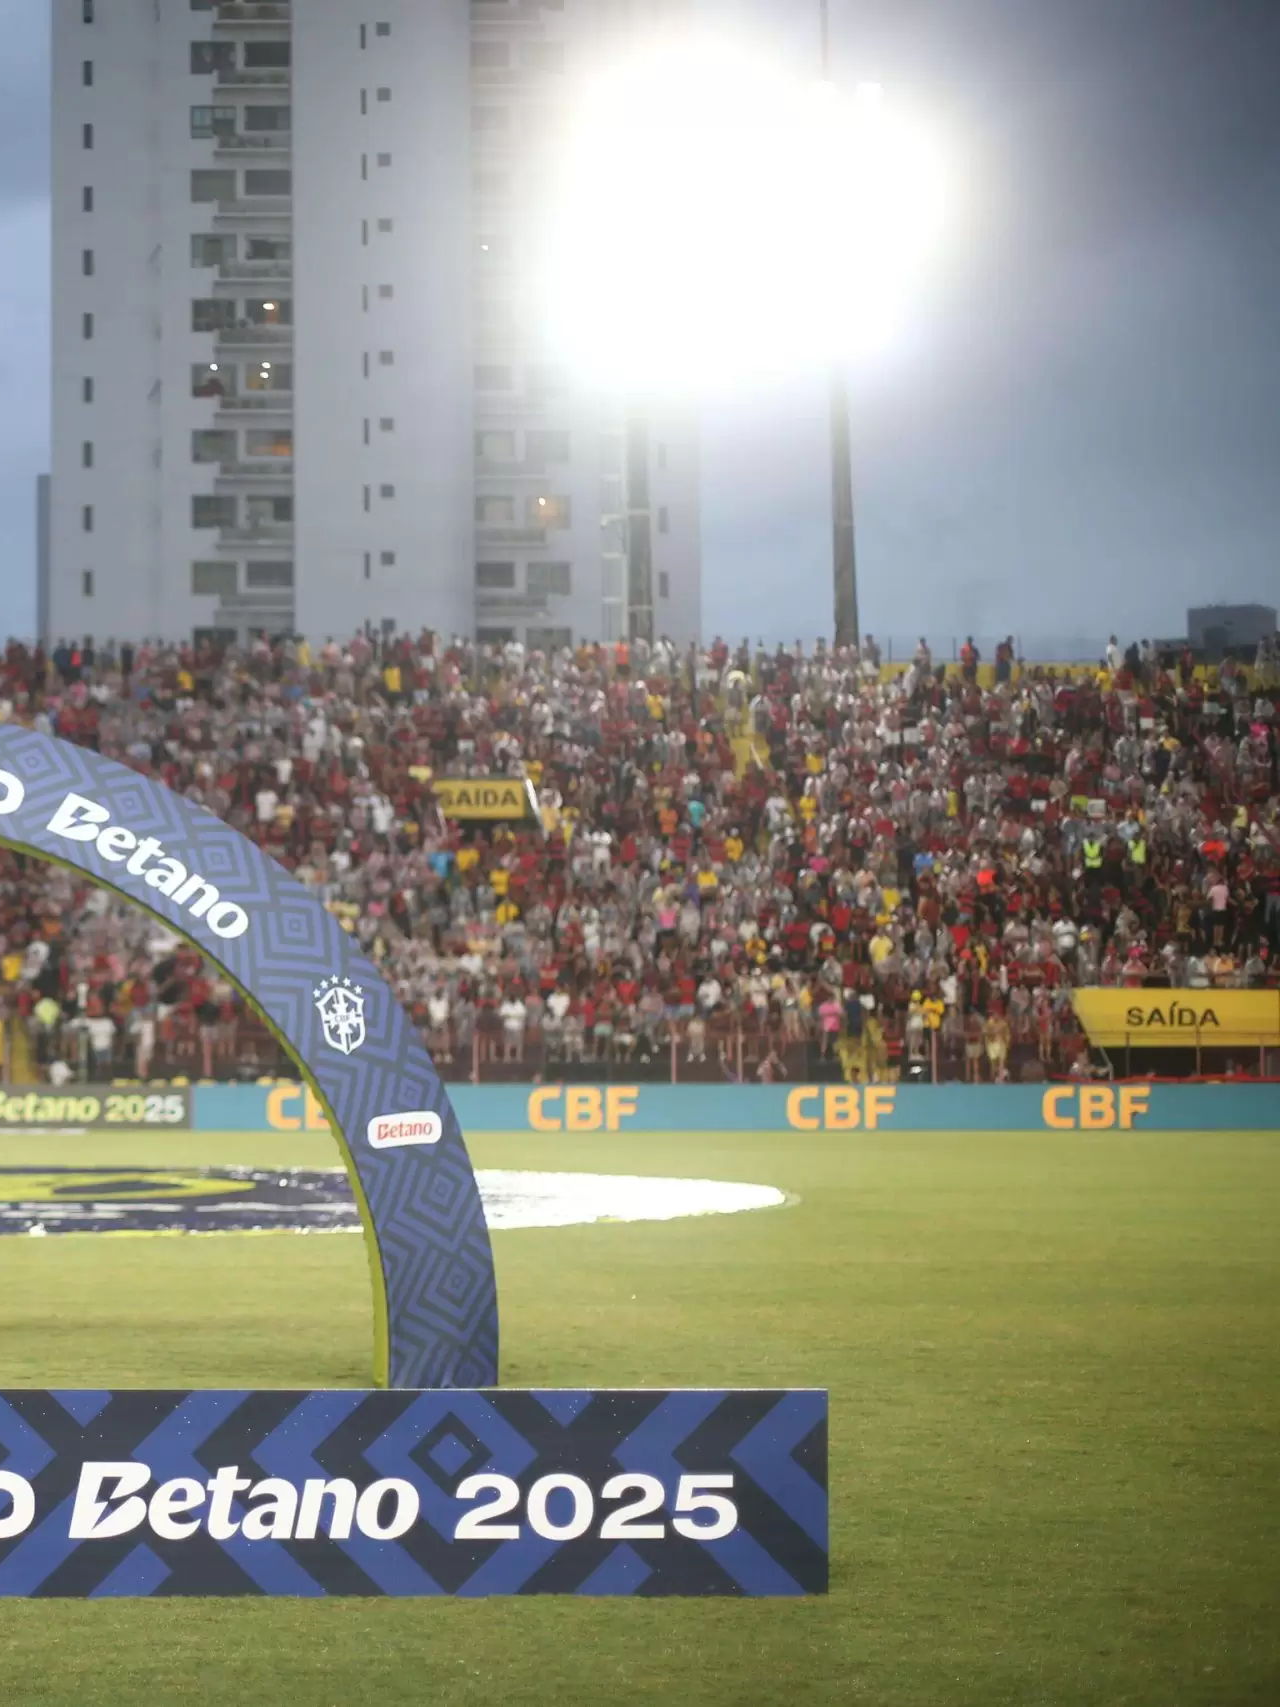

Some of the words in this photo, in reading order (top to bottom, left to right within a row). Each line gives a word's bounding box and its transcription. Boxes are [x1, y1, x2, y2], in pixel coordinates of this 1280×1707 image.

[46, 792, 250, 940] Betano
[1125, 1001, 1221, 1027] SAÍDA
[104, 1094, 185, 1122] 2025
[527, 1086, 639, 1131] CBF
[786, 1086, 896, 1129] CBF
[1042, 1086, 1151, 1129] CBF
[377, 1121, 433, 1141] Betano
[68, 1460, 420, 1541] Betano
[454, 1473, 738, 1541] 2025
